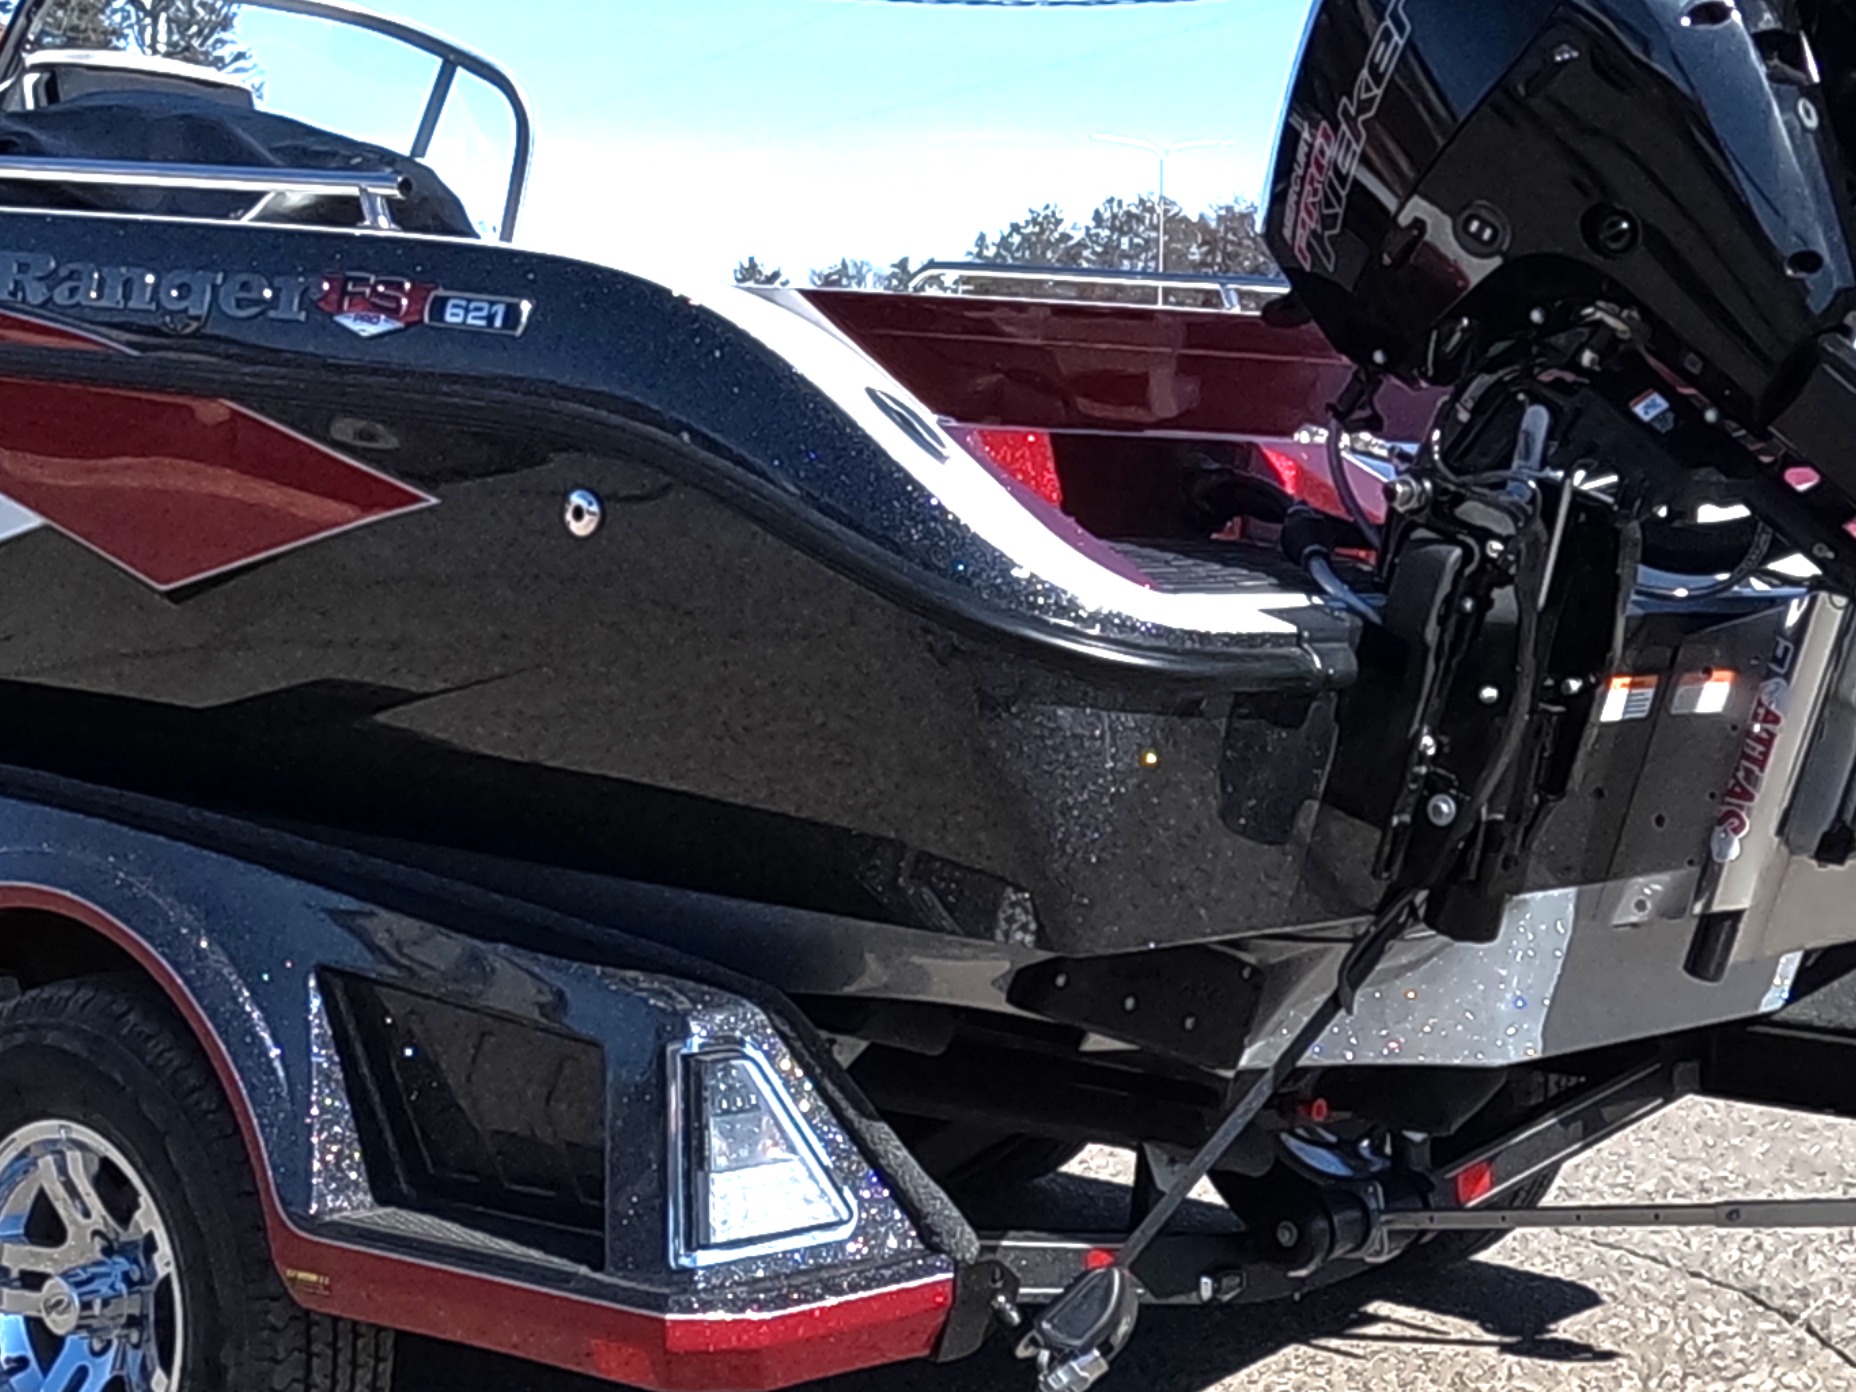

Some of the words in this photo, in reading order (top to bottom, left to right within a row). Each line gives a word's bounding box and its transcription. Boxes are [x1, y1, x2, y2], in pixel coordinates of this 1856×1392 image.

[1281, 119, 1313, 247] MERCURY
[342, 271, 411, 318] FS
[443, 297, 507, 329] 621
